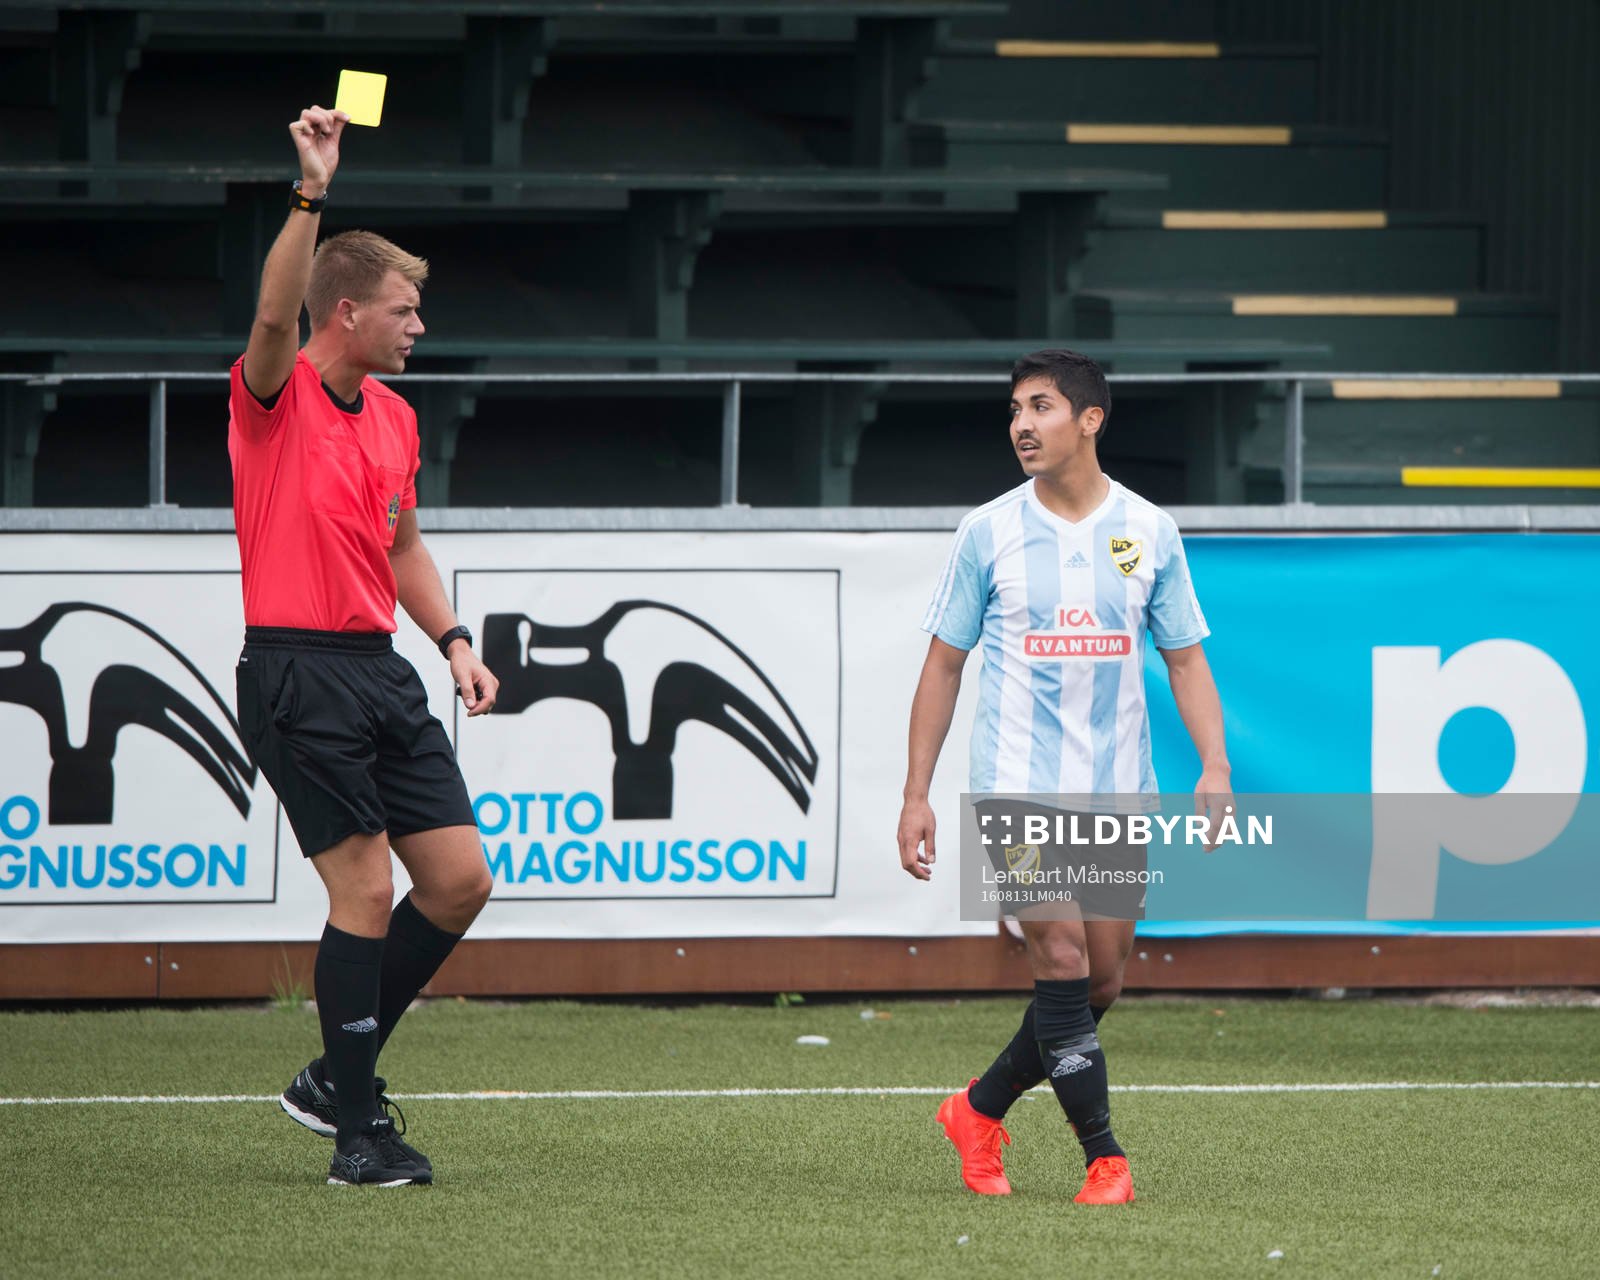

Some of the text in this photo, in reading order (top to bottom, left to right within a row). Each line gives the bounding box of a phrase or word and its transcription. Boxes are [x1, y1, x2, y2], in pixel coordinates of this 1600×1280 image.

[1060, 609, 1096, 627] ICA
[1030, 639, 1123, 653] KVANTUM
[1366, 638, 1588, 920] p
[472, 792, 604, 836] OTTO
[482, 839, 807, 884] MAGNUSSON
[1052, 1059, 1093, 1078] adidas
